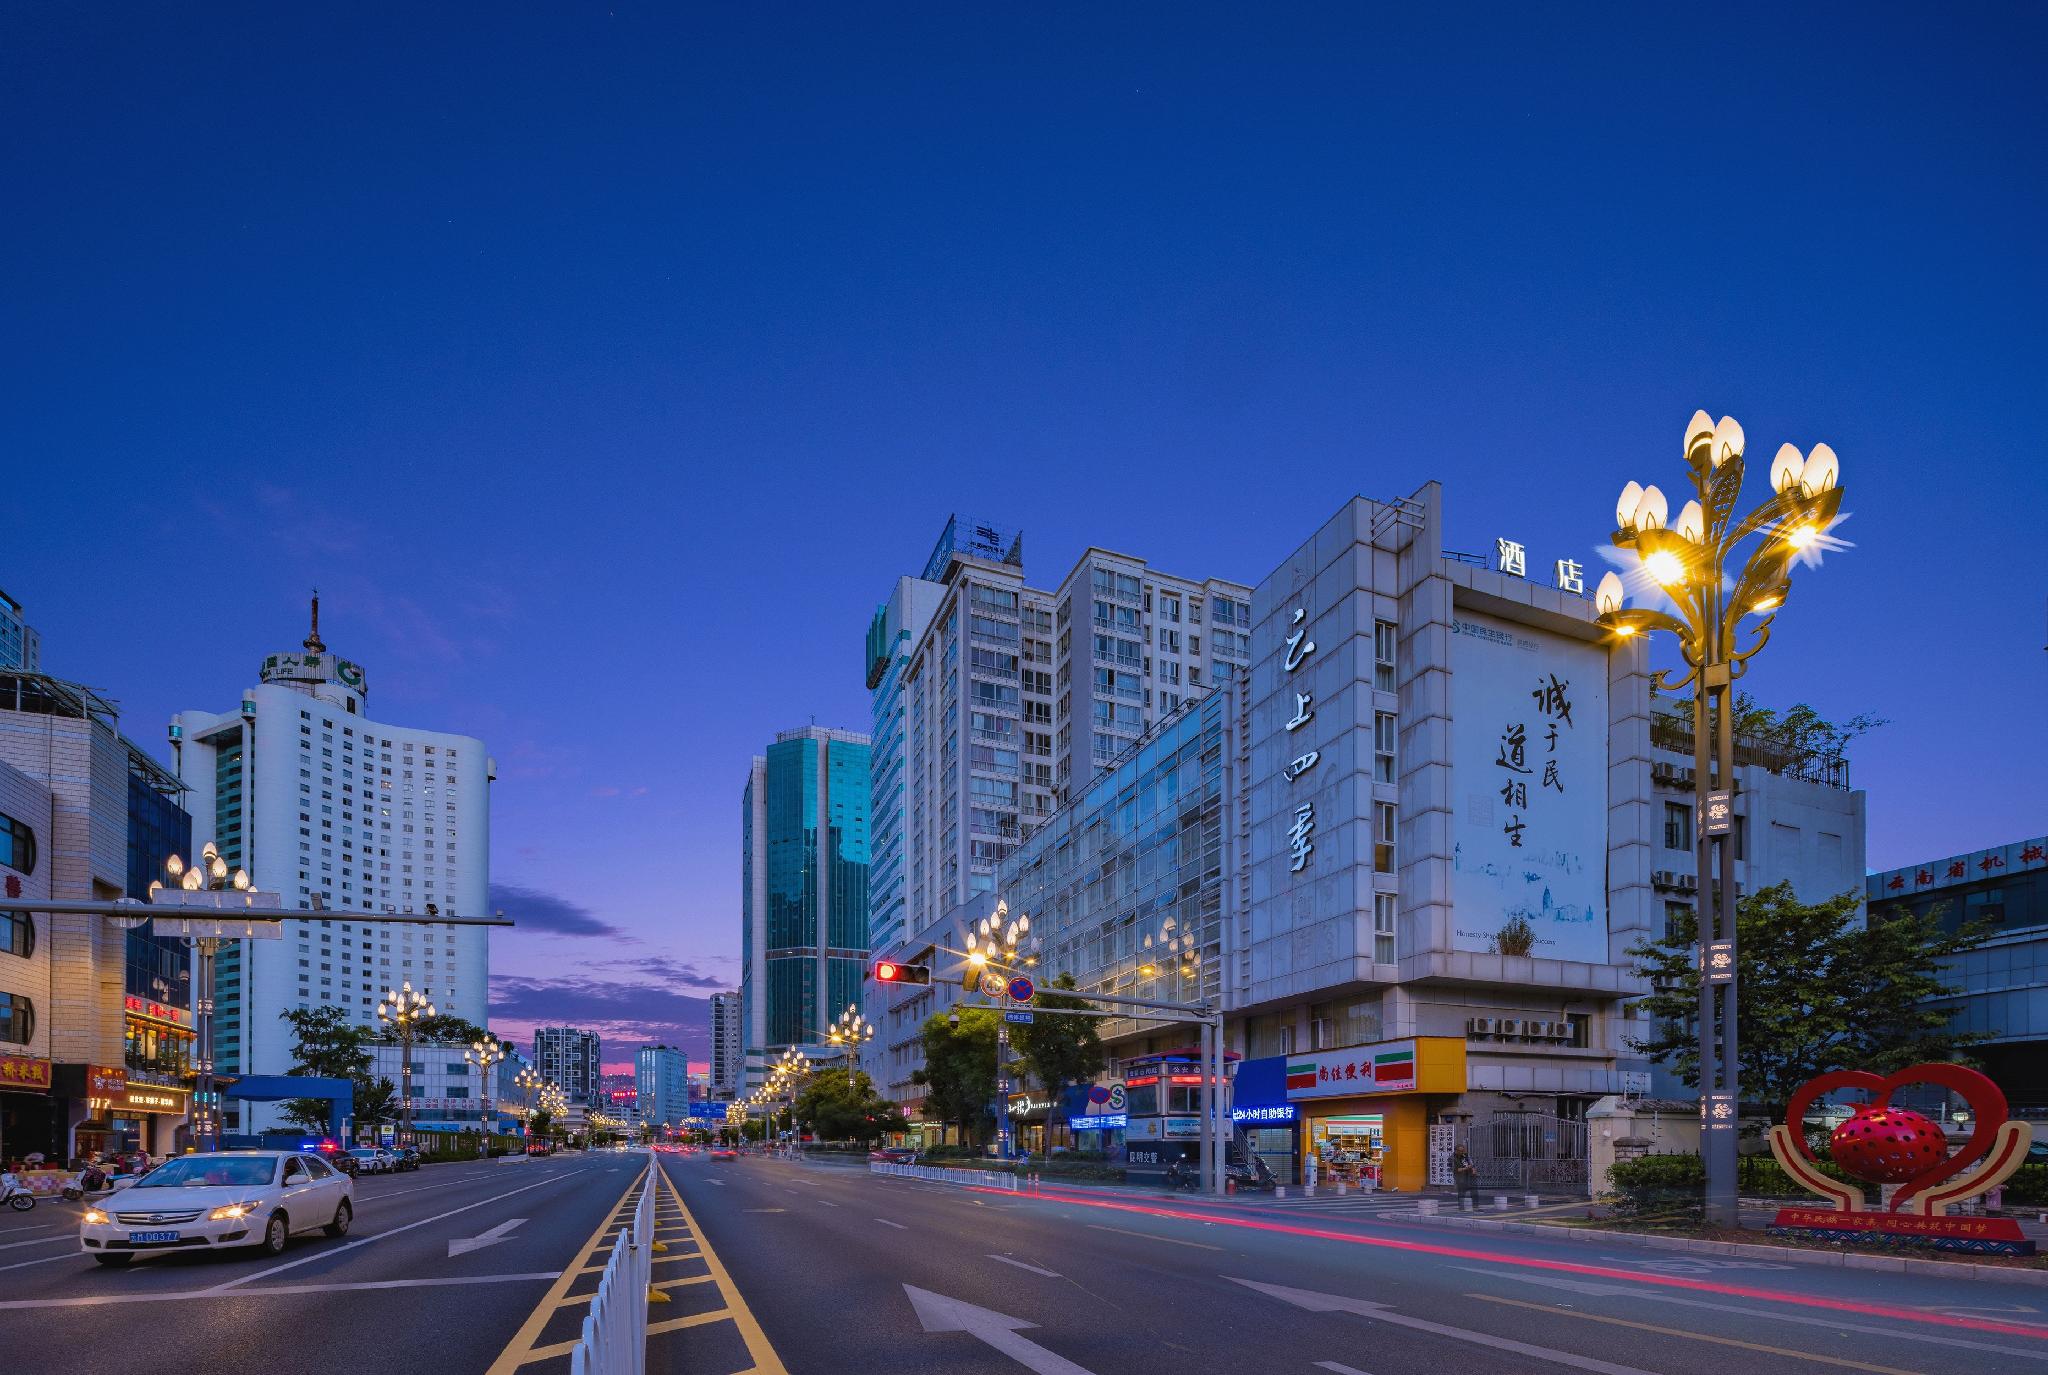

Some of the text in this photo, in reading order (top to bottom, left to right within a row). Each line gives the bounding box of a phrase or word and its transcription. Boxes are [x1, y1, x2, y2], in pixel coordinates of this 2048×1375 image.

[1497, 537, 1584, 594] 酒店
[1462, 623, 1513, 642] 中国民生银行
[1284, 608, 1319, 872] 云上四季
[1495, 723, 1533, 847] 道相生
[1532, 672, 1573, 794] 诚于民
